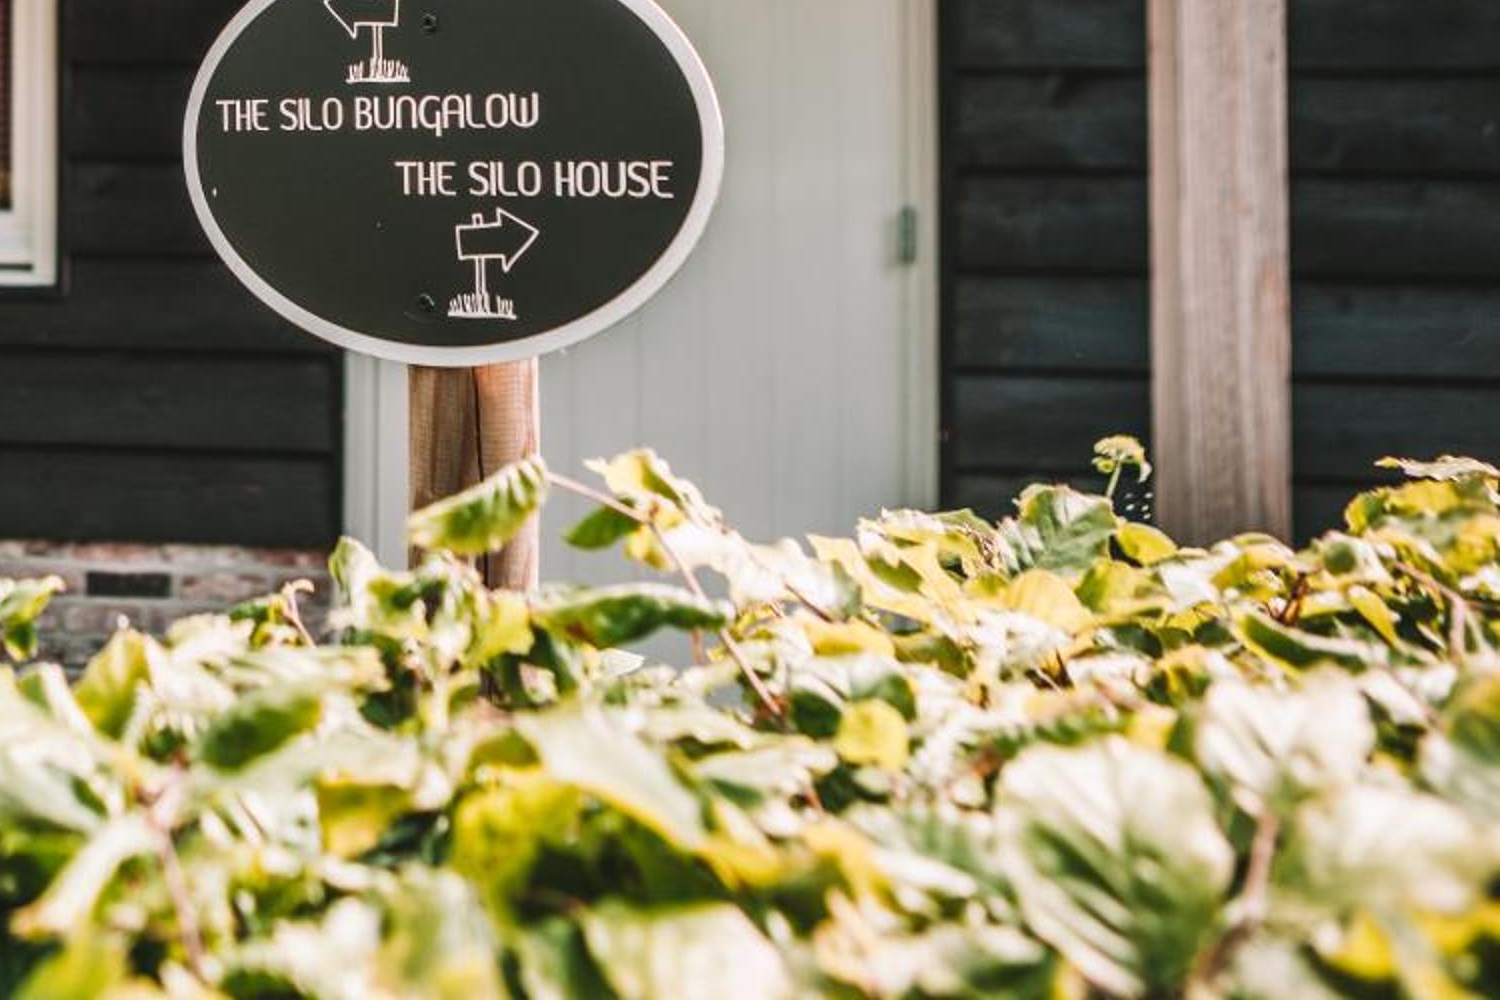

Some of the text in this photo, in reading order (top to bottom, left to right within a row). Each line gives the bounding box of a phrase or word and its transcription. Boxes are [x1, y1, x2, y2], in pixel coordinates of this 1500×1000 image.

[215, 91, 540, 138] THE SILO BUNGALOW
[393, 160, 675, 199] THE SILO HOUSE
